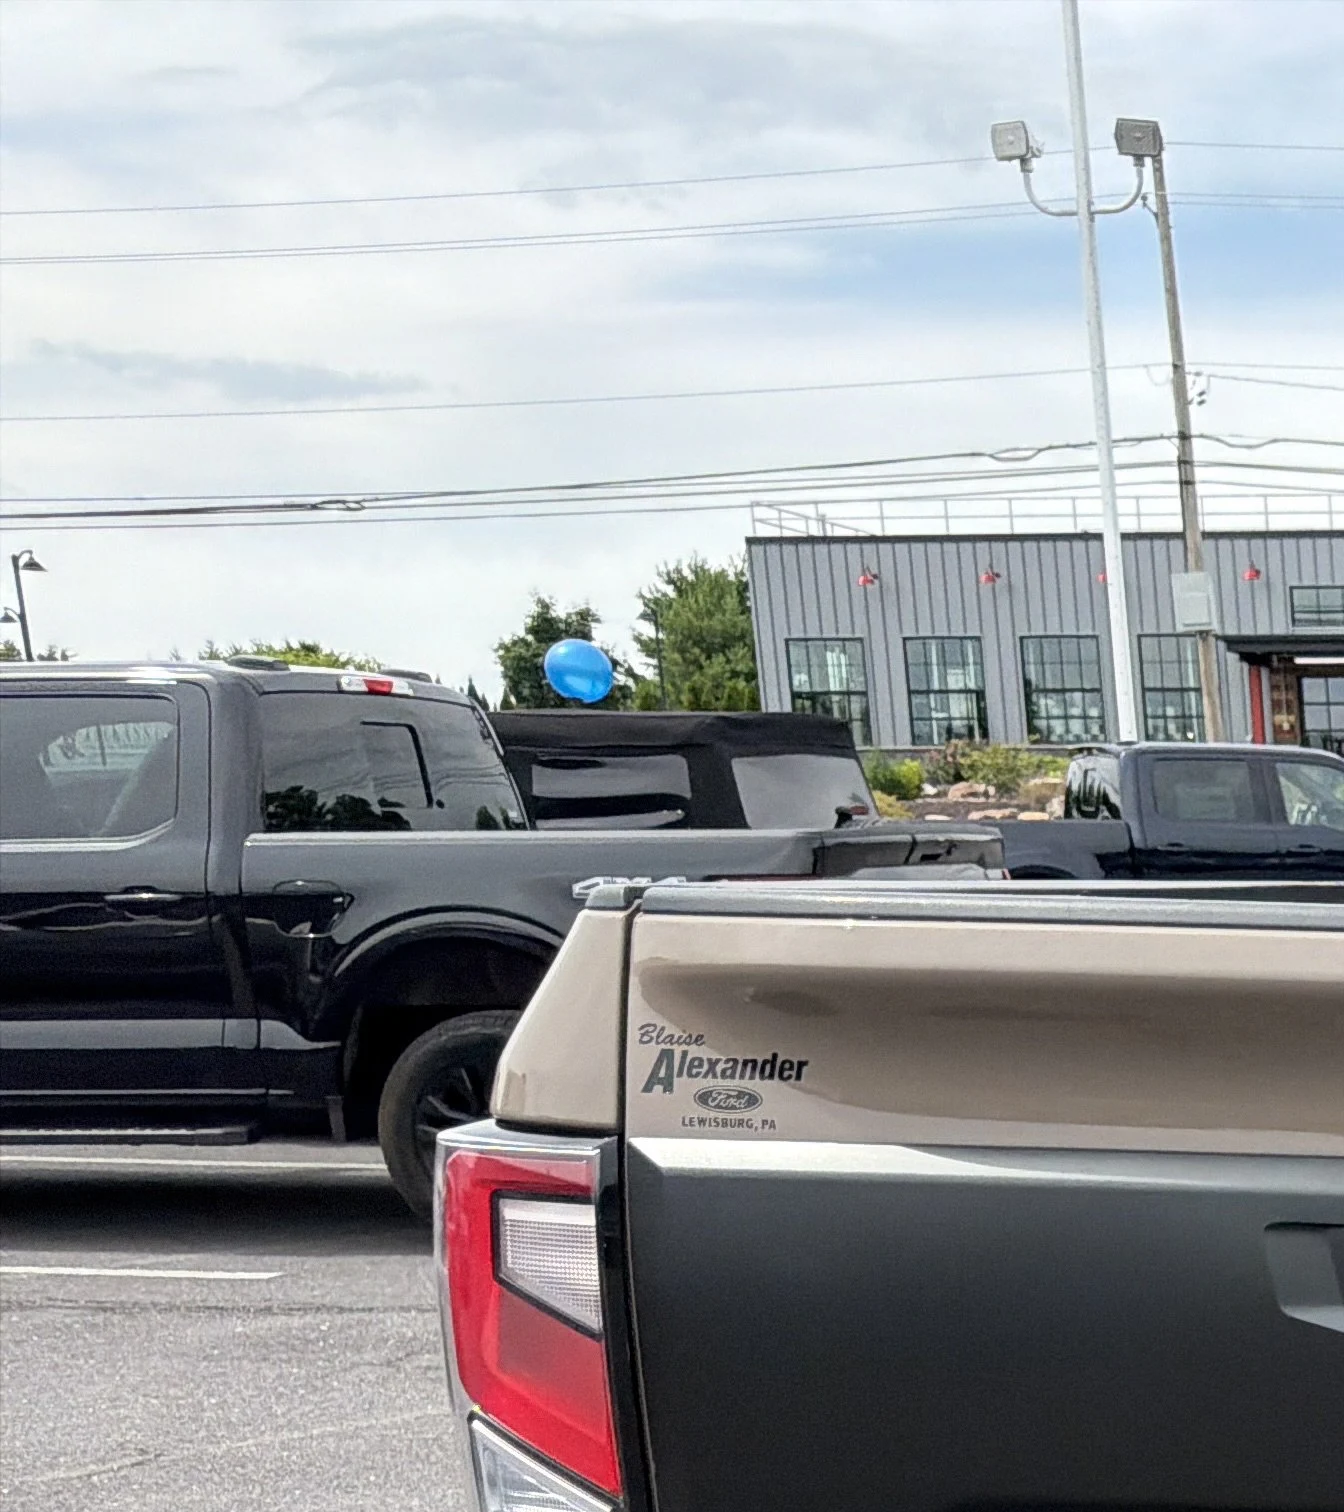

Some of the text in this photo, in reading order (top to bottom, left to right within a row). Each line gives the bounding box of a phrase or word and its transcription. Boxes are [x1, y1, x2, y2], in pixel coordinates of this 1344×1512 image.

[638, 1023, 706, 1047] Blaise
[641, 1048, 810, 1095] Alexander
[707, 1089, 749, 1110] Ford
[682, 1116, 777, 1132] LEWISBURG, PA
